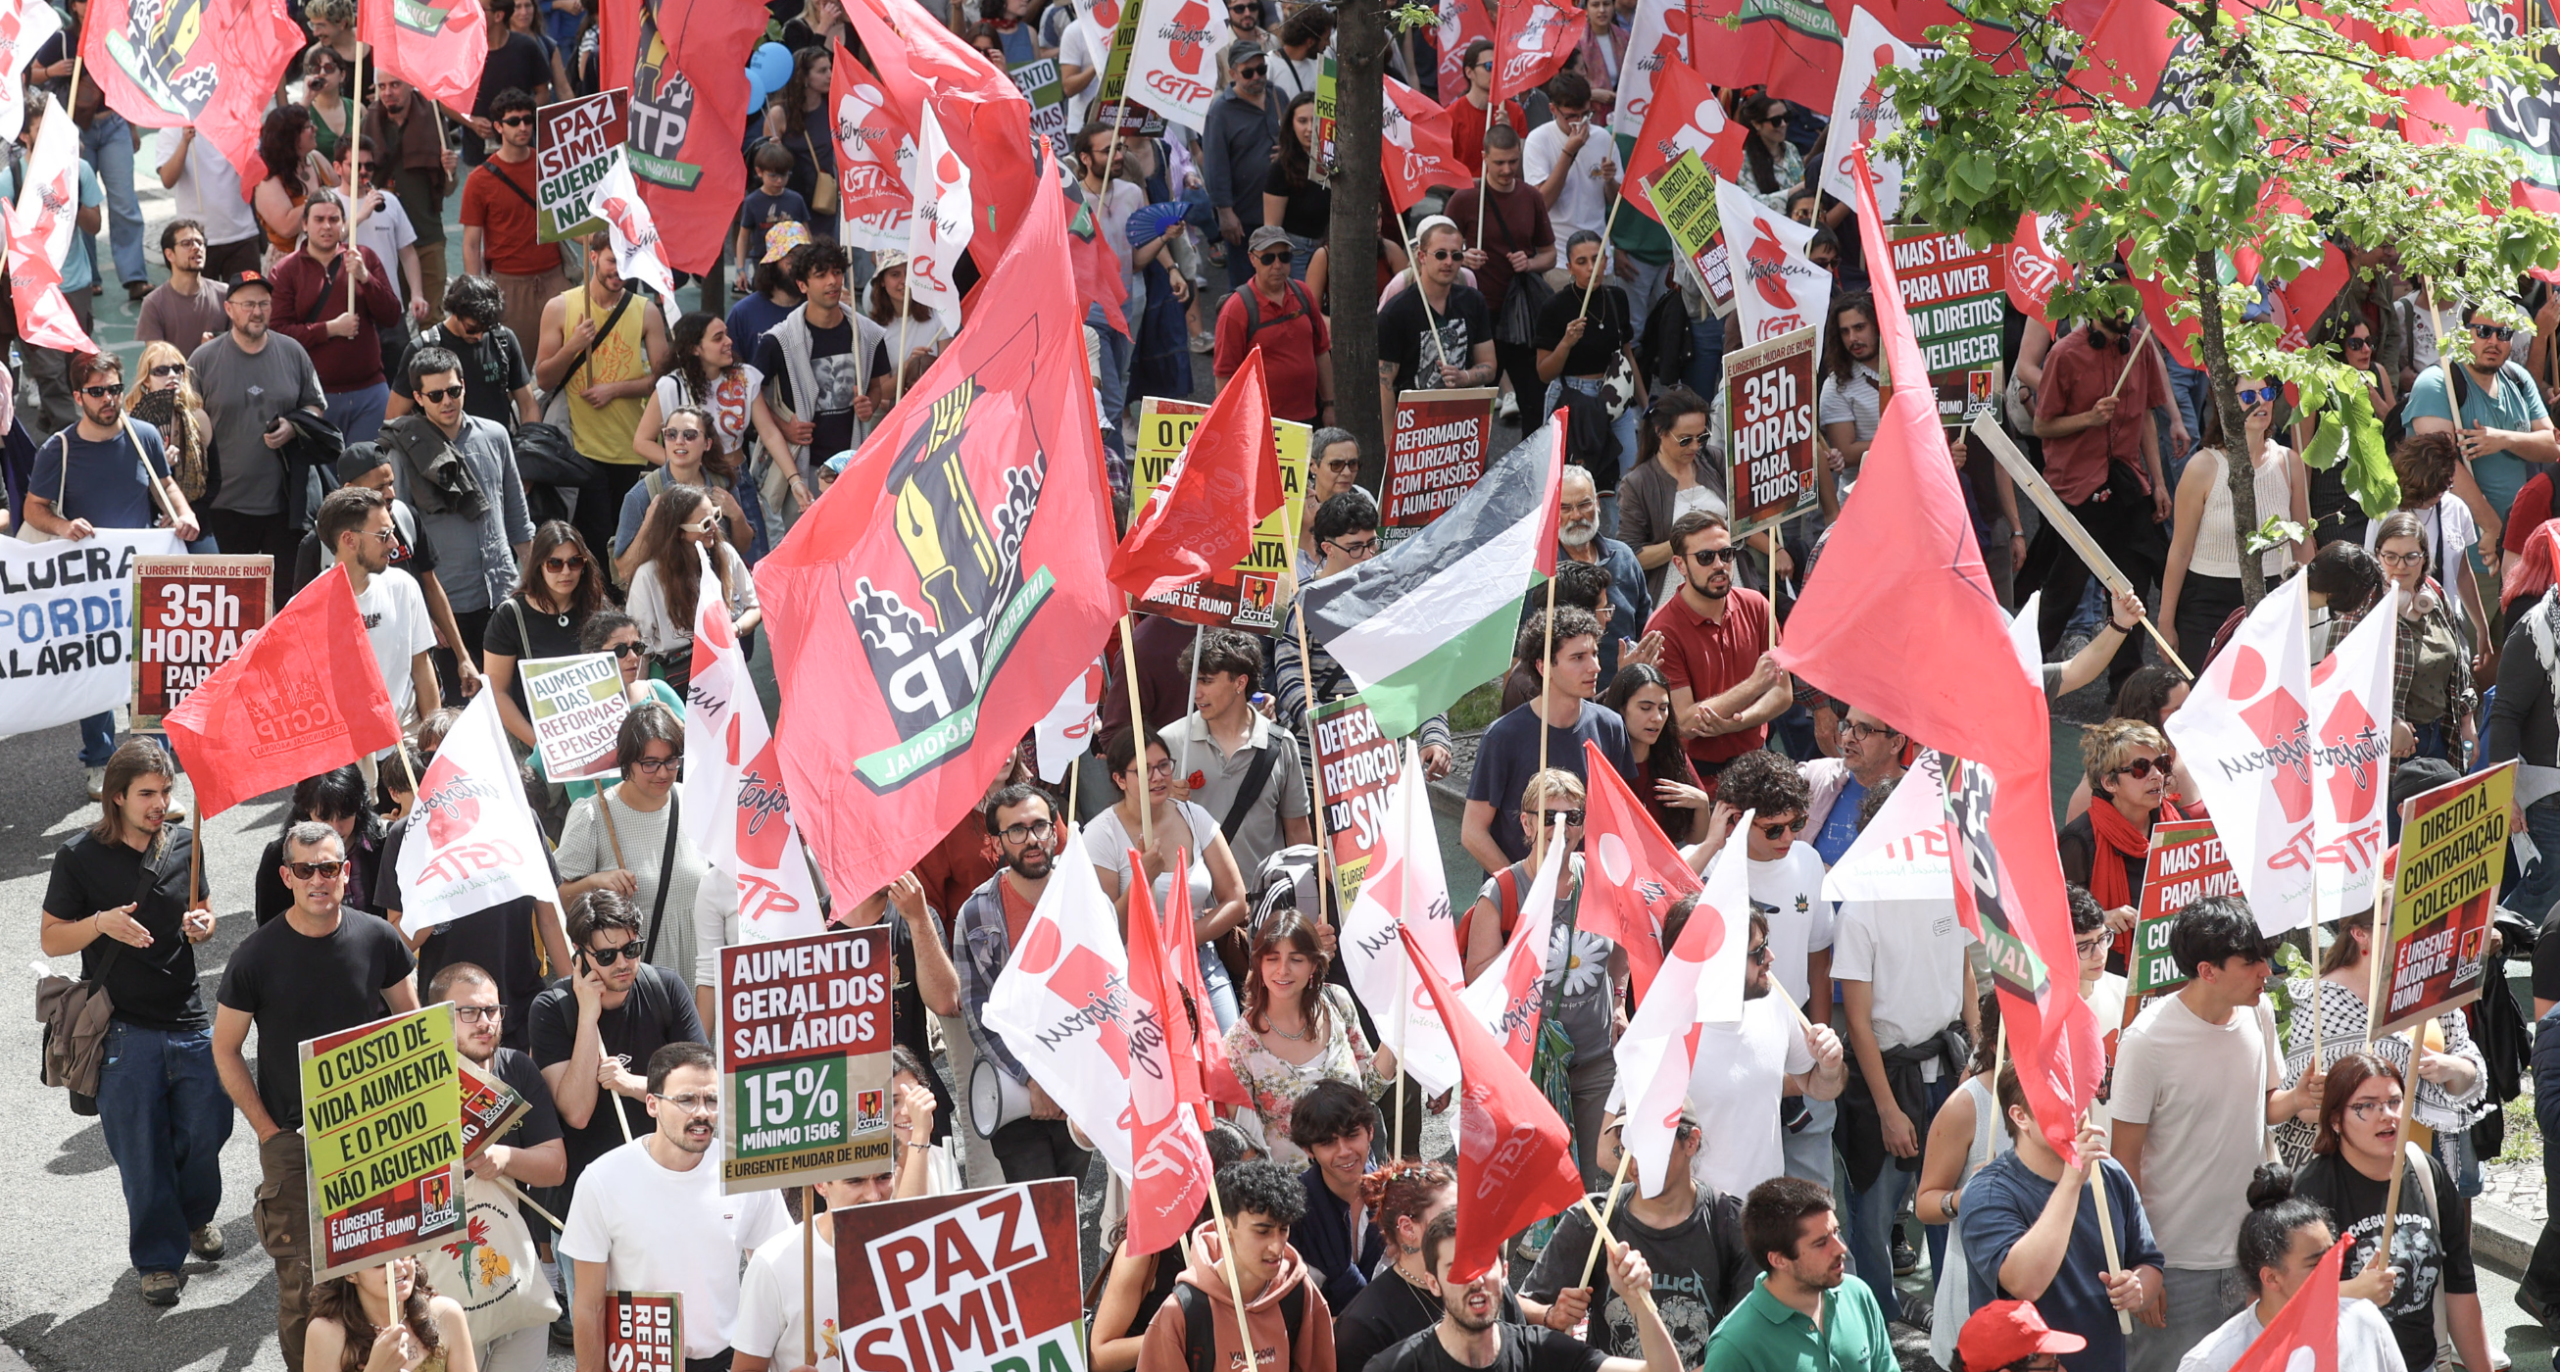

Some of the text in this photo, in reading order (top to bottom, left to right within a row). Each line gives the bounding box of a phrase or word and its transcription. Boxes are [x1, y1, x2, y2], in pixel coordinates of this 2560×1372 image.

[1117, 27, 1136, 46] VID
[1105, 76, 1124, 98] NÃ
[1145, 69, 1213, 105] CGTP
[553, 95, 613, 144] PAZ
[542, 128, 605, 178] SIM!
[1658, 169, 1688, 204] DIREITO
[1668, 175, 1715, 231] CONTRATAÇÃO
[556, 192, 595, 230] NÃ
[1894, 238, 1936, 271] MAIS
[1900, 264, 1990, 305] PARA VIVER
[1932, 297, 2003, 334] DIREITOS
[1732, 356, 1762, 374] URGENTE
[1762, 346, 1786, 364] MUDAR
[1786, 343, 1796, 356] DE
[1797, 336, 1815, 352] RUMO
[1743, 366, 1797, 423] 35h
[1939, 400, 1963, 415] RUMO
[1158, 420, 1173, 447] O
[1395, 417, 1479, 453] REFORMADOS
[1397, 409, 1415, 430] OS
[1733, 404, 1812, 466] HORAS
[1393, 435, 1480, 474] VALORIZAR SÓ
[1751, 450, 1791, 485] PARA
[1392, 460, 1480, 497] COM PENSÕES
[1751, 470, 1799, 508] TODOS
[1390, 498, 1400, 519] A
[137, 563, 272, 577] É URGENTE MUDAR DE RUMO
[160, 583, 240, 628] 35h
[1181, 594, 1196, 609] DE
[1199, 596, 1233, 617] RUMO
[1241, 608, 1271, 621] CGTP
[533, 659, 610, 699] AUMENTO
[538, 696, 625, 740] REFORMAS
[555, 688, 590, 713] DAS
[546, 743, 561, 761] E
[1323, 743, 1398, 798] REFORÇO
[1331, 802, 1351, 832] DO
[2420, 782, 2488, 849] DIREITO À
[2160, 842, 2201, 878] MAIS
[2403, 812, 2504, 896] CONTRATAÇÃO
[2413, 859, 2489, 927] COLECTIVA
[732, 937, 870, 987] AUMENTO
[2398, 926, 2457, 968] É URGENTE
[2395, 949, 2452, 991] MUDAR DE
[732, 972, 885, 1023] GERAL DOS
[2390, 981, 2424, 1014] RUMO
[317, 1016, 431, 1090] O CUSTO DE
[734, 1010, 875, 1059] SALÁRIOS
[308, 1048, 453, 1133] VIDA AUMENTA
[744, 1064, 839, 1128] 15%
[340, 1100, 428, 1163] E O POVO
[742, 1120, 840, 1152] MÍNIMO 150€
[858, 1117, 883, 1130] CGTP
[323, 1129, 457, 1211] NÃO AGUENTA
[725, 1141, 890, 1179] É URGENTE MUDAR DE RUMO
[331, 1207, 385, 1237] É URGENTE
[332, 1214, 416, 1253] MUDAR DE RUMO
[424, 1210, 453, 1226] CGTP
[877, 1191, 1038, 1312] PAZ
[619, 1304, 634, 1338] DO
[854, 1279, 1020, 1372] SIM!
